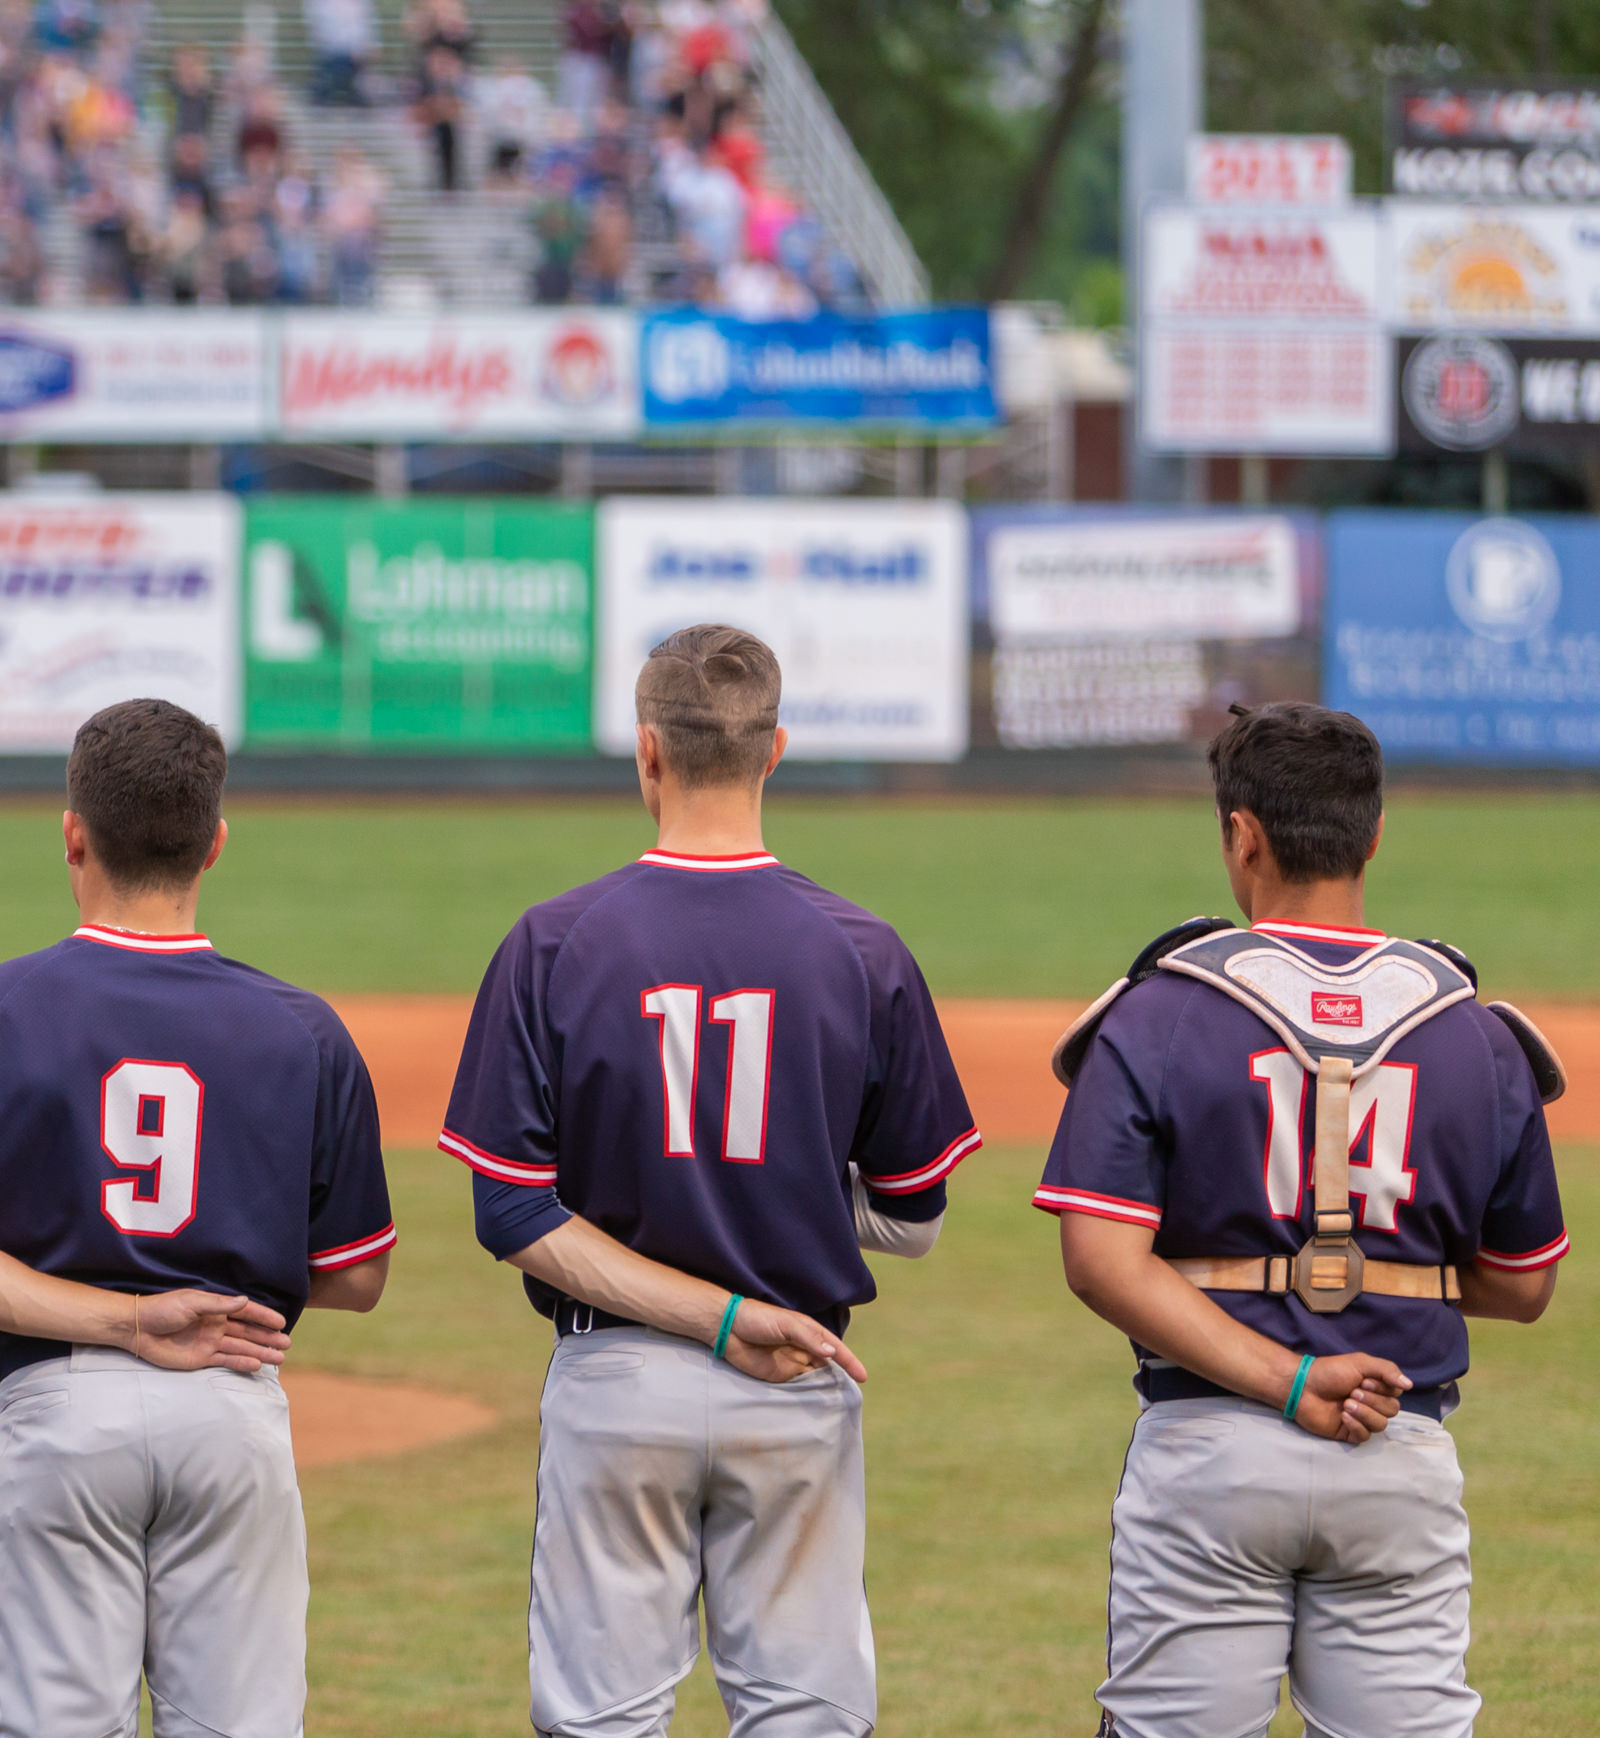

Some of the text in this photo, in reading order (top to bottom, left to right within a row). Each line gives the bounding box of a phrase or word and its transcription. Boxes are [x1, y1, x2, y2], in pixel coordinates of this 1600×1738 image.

[640, 982, 776, 1165] 11
[1316, 1000, 1358, 1018] Rawlings
[101, 1057, 204, 1238] 9
[1248, 1046, 1418, 1234] 14
